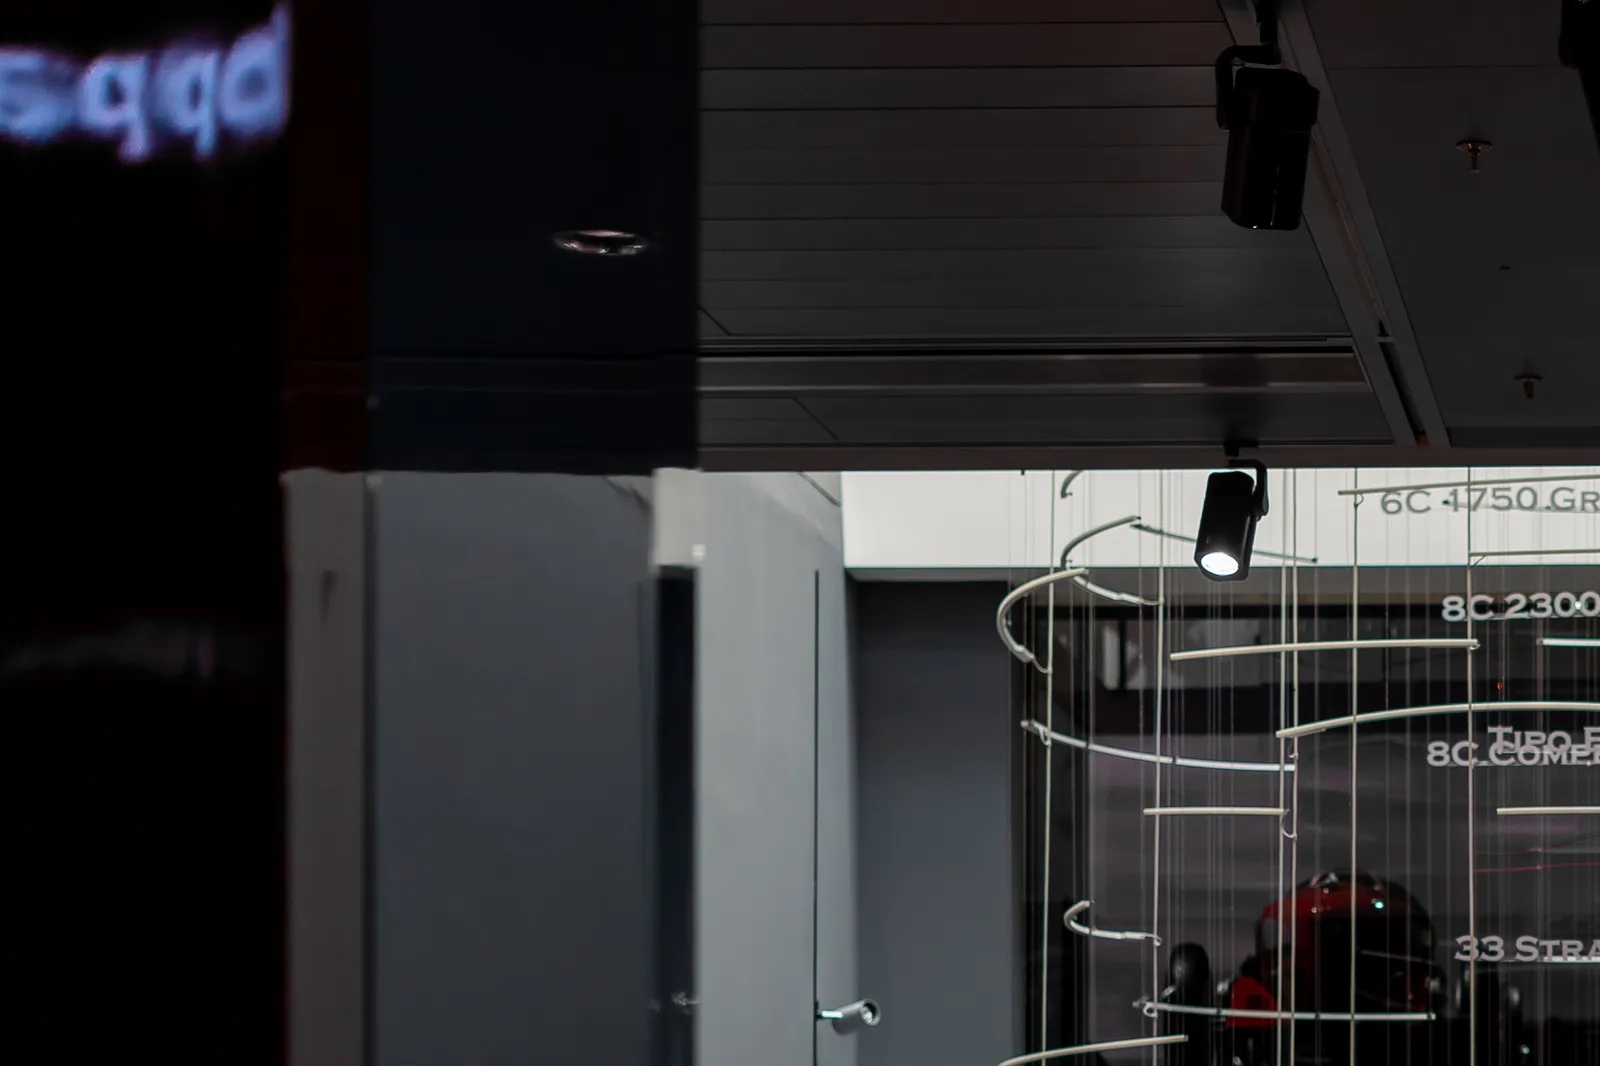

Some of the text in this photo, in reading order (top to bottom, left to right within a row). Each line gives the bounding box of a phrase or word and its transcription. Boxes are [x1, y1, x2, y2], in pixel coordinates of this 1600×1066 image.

[1380, 489, 1431, 515] 6C
[1446, 486, 1538, 513] 1750
[1442, 595, 1494, 622] 8C
[1427, 741, 1478, 766] 8C
[1488, 726, 1571, 754] TIPO
[1454, 935, 1505, 962] 33
